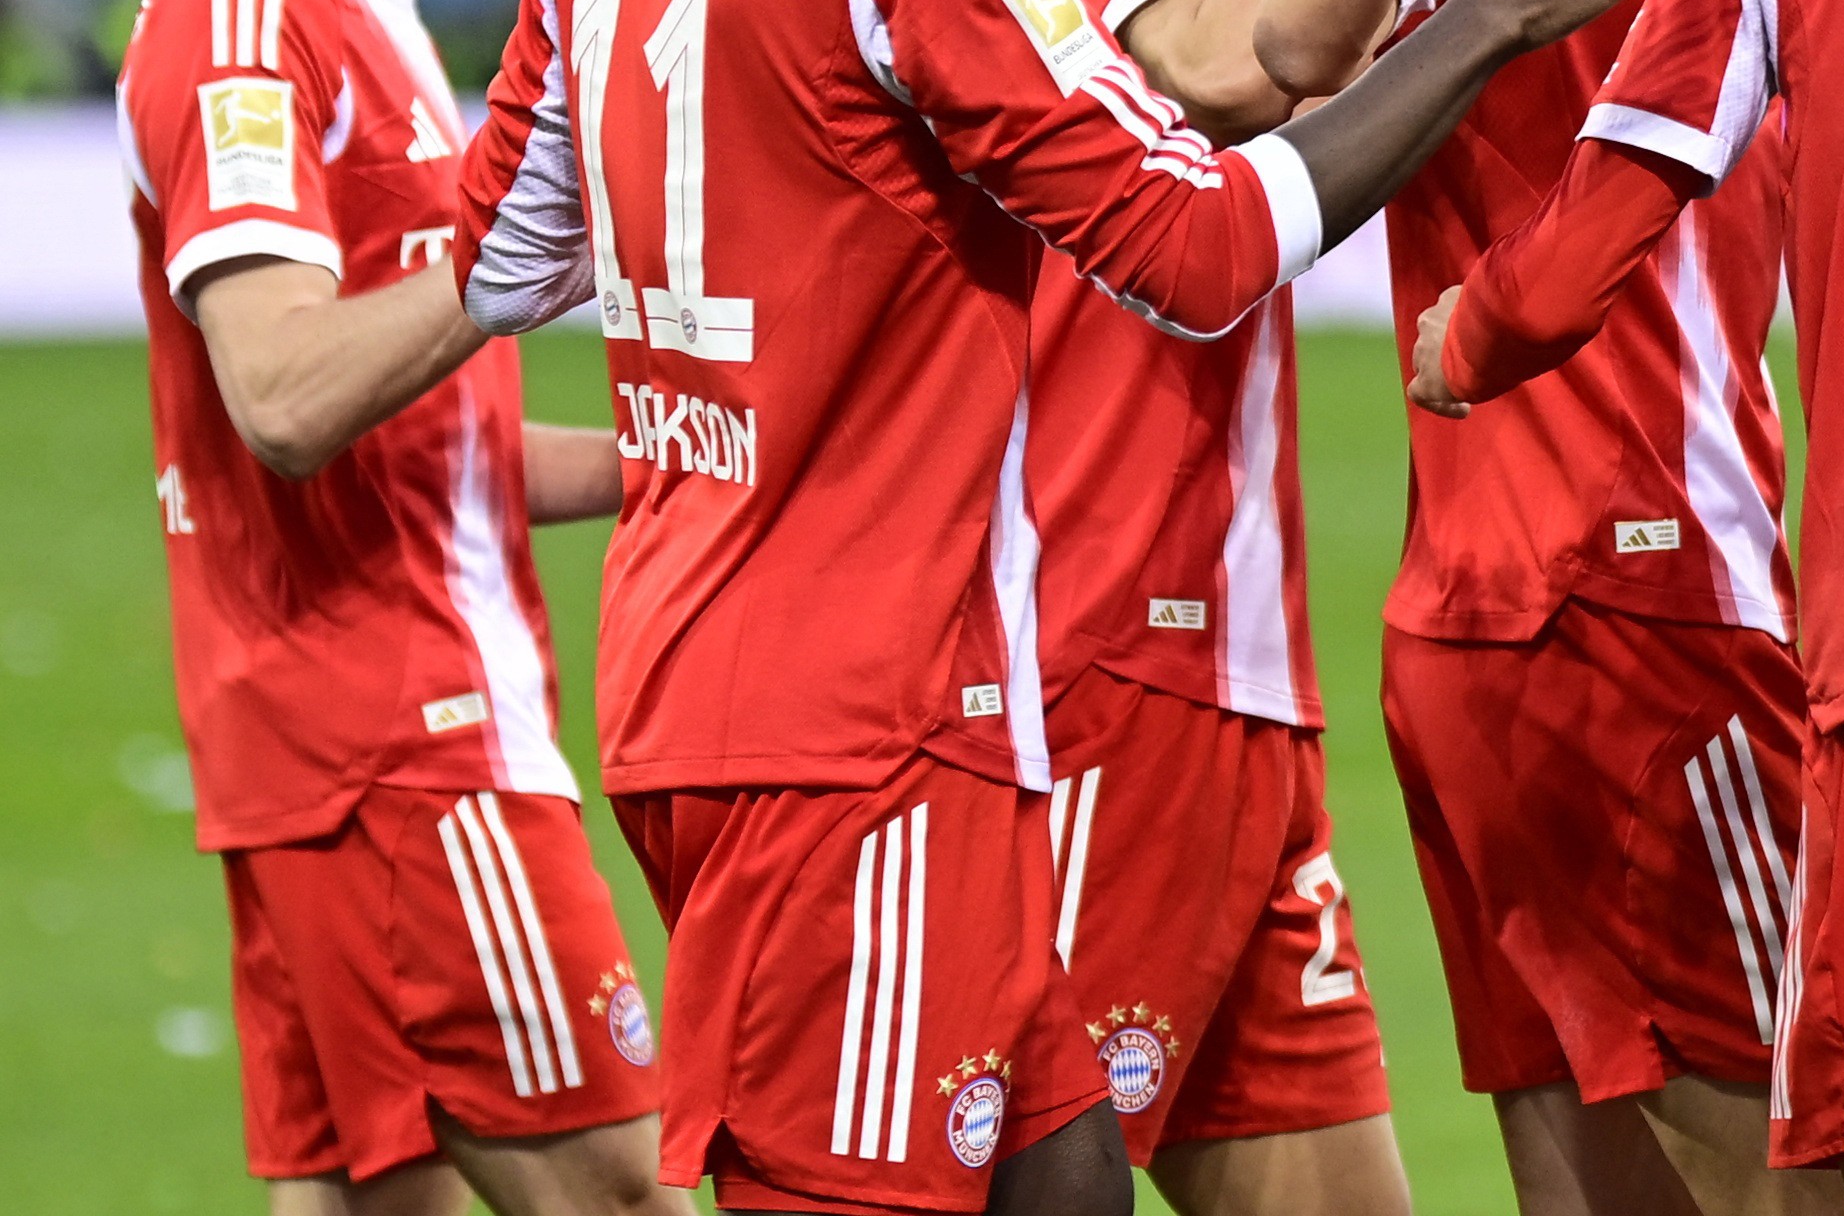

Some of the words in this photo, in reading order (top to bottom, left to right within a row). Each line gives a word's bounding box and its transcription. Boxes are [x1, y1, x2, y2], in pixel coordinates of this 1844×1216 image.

[1102, 1041, 1119, 1062] FC
[1119, 1034, 1160, 1070] BAYERN
[1109, 1082, 1156, 1109] NCHEN
